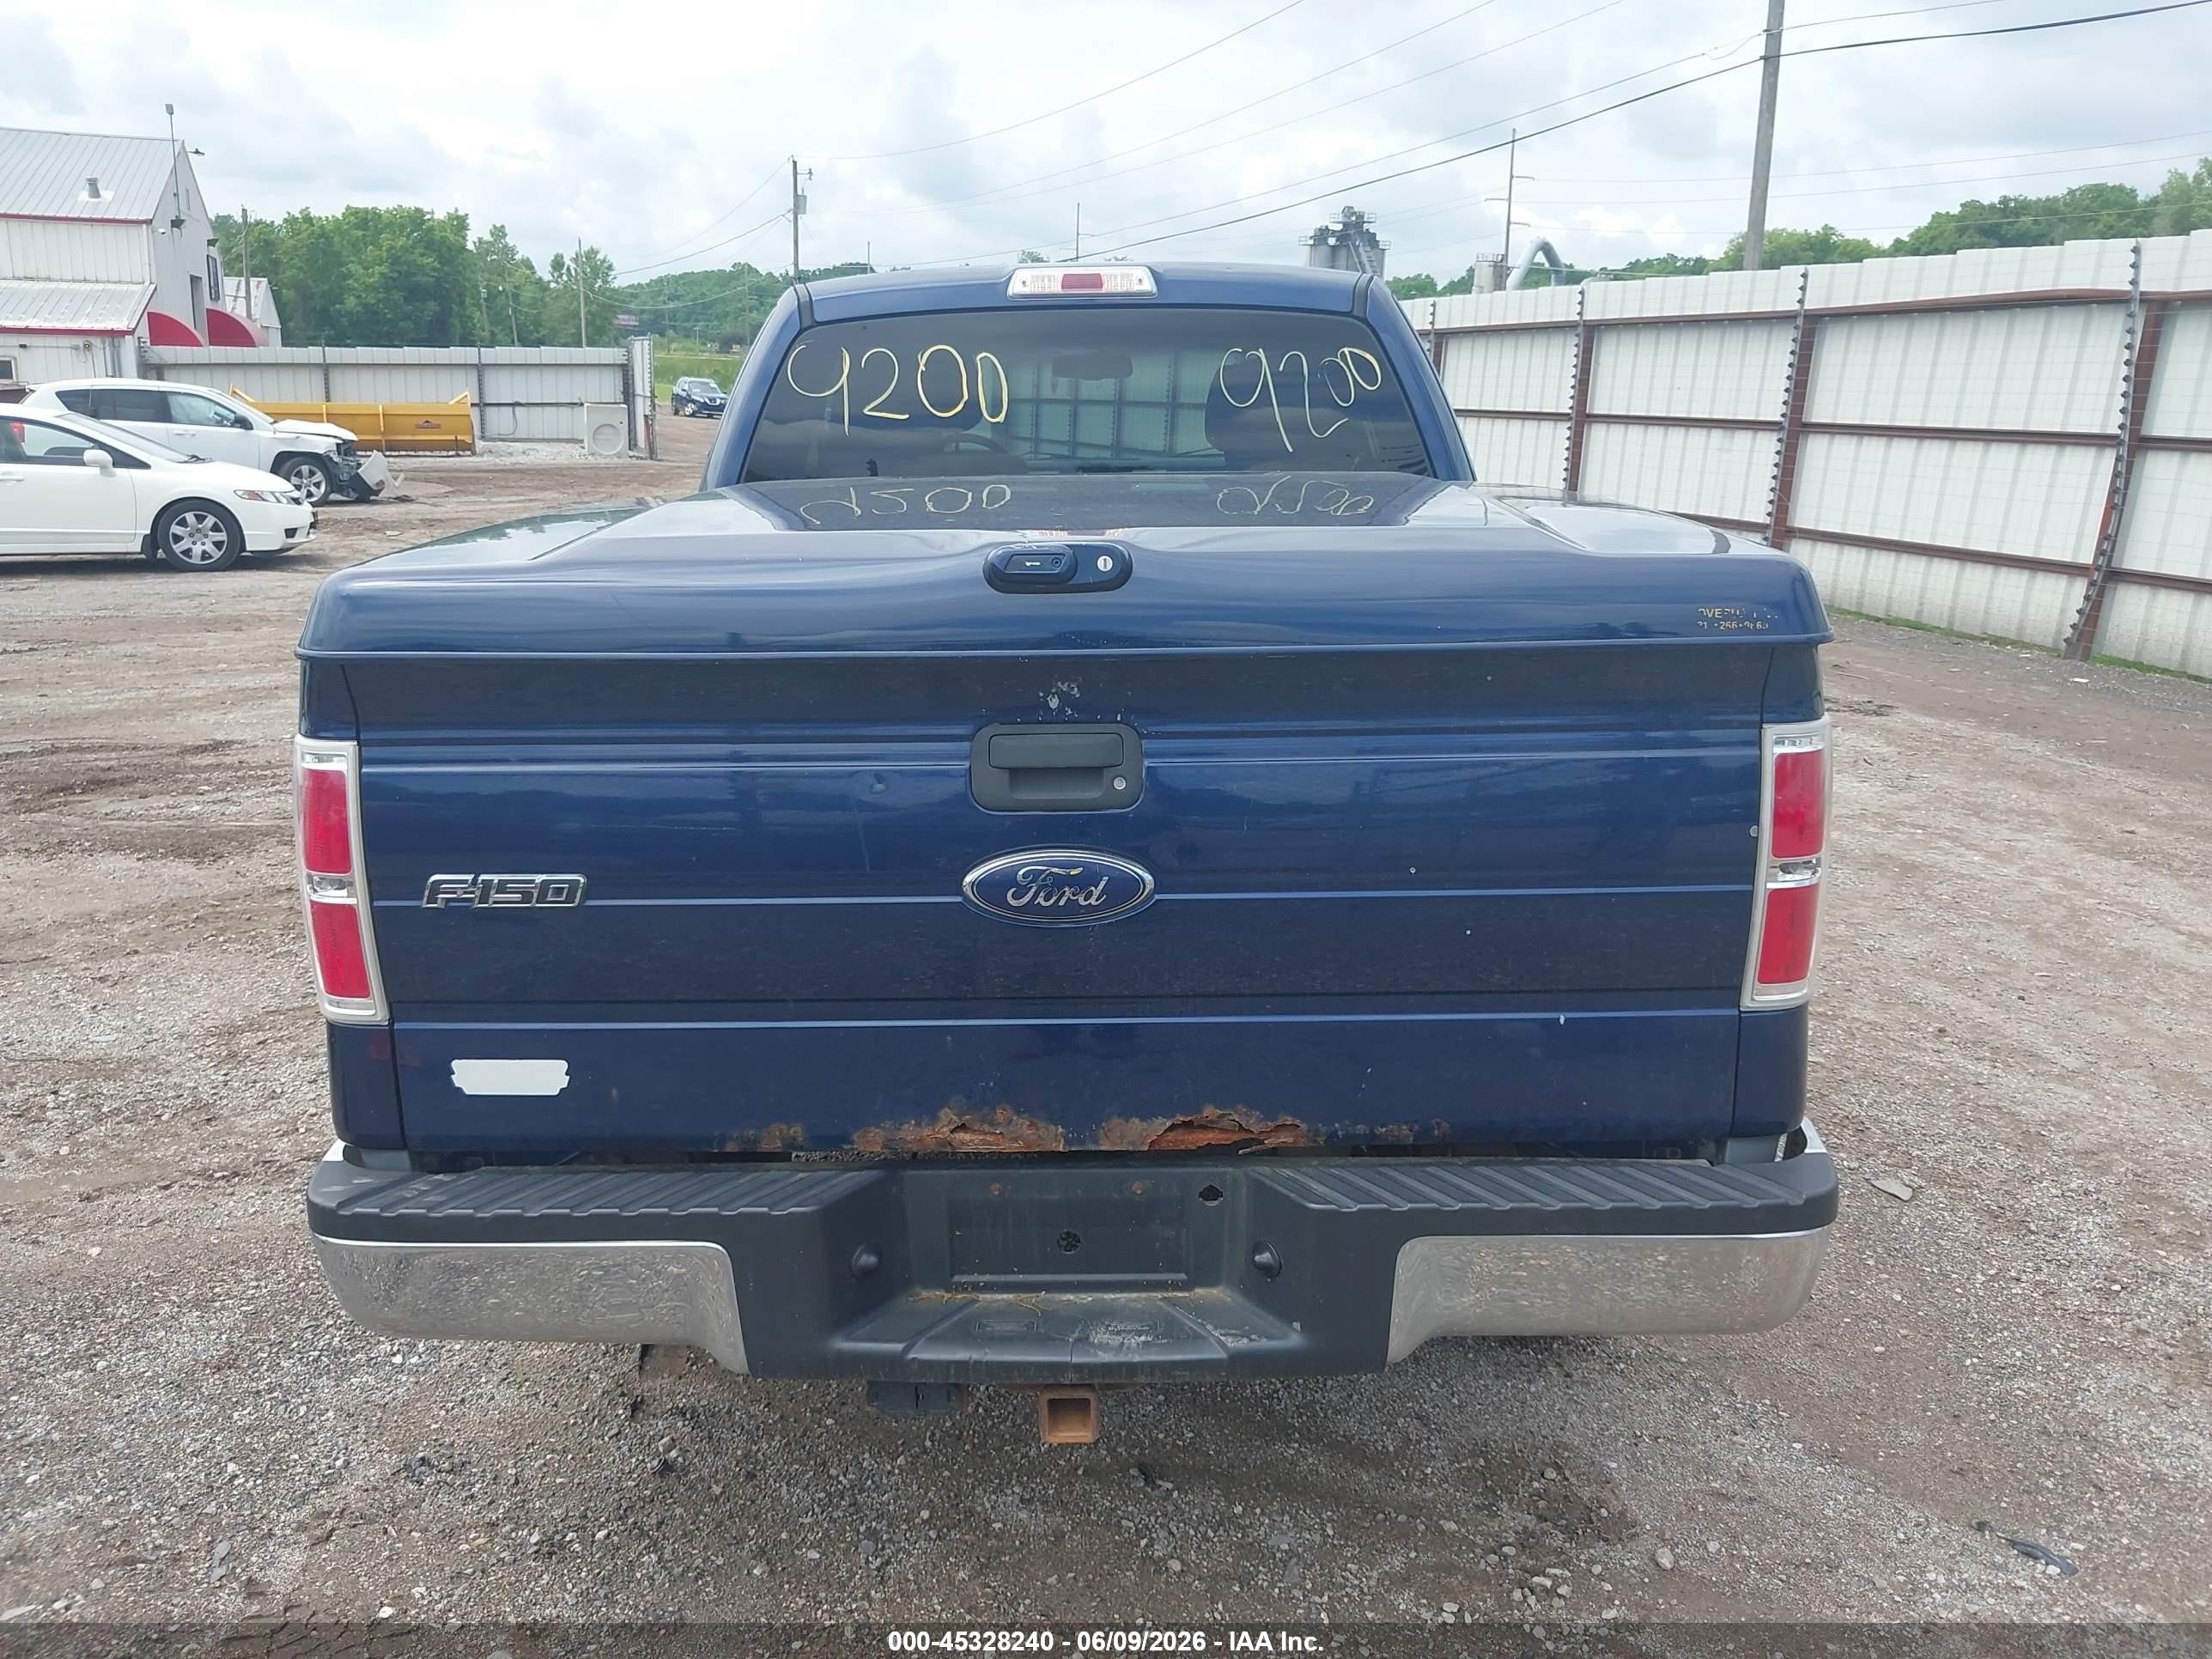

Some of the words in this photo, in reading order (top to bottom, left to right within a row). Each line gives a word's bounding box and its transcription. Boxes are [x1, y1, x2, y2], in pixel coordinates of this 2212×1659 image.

[787, 343, 1009, 434] 9200
[1219, 347, 1382, 453] 9200
[422, 872, 587, 908] F-150
[1006, 865, 1109, 908] Ford
